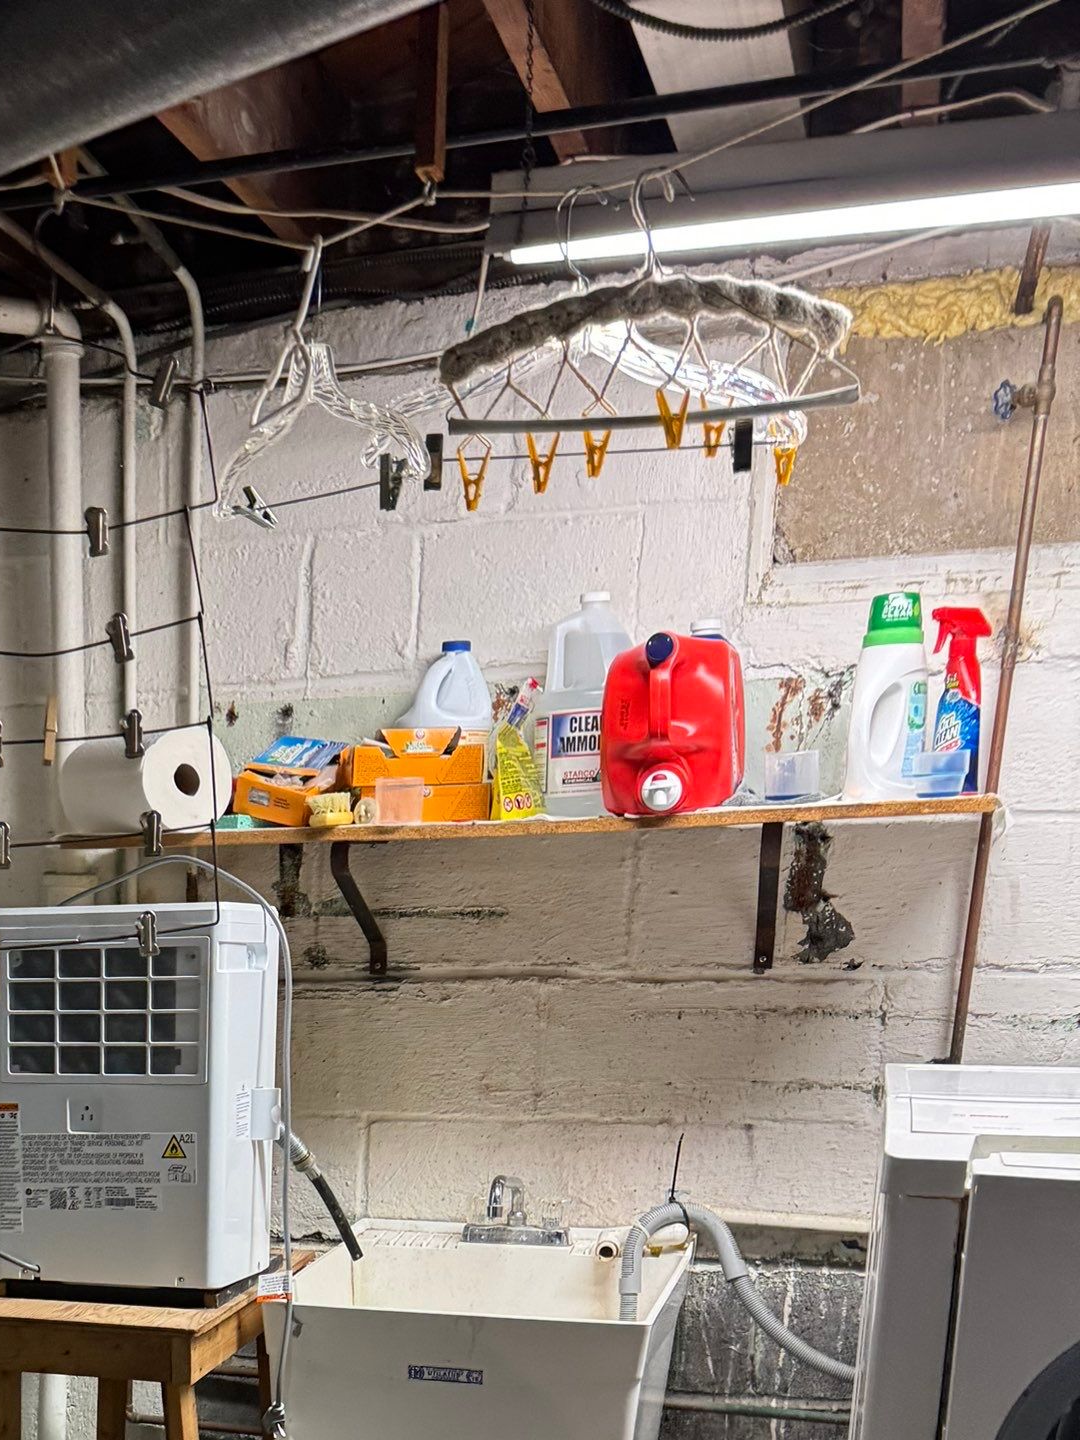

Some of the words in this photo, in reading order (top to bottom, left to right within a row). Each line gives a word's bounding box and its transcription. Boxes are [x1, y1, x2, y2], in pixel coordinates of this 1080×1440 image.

[569, 714, 602, 734] CLEA
[558, 733, 602, 753] AMMO
[563, 768, 595, 779] STARCO
[179, 1134, 195, 1144] A2L
